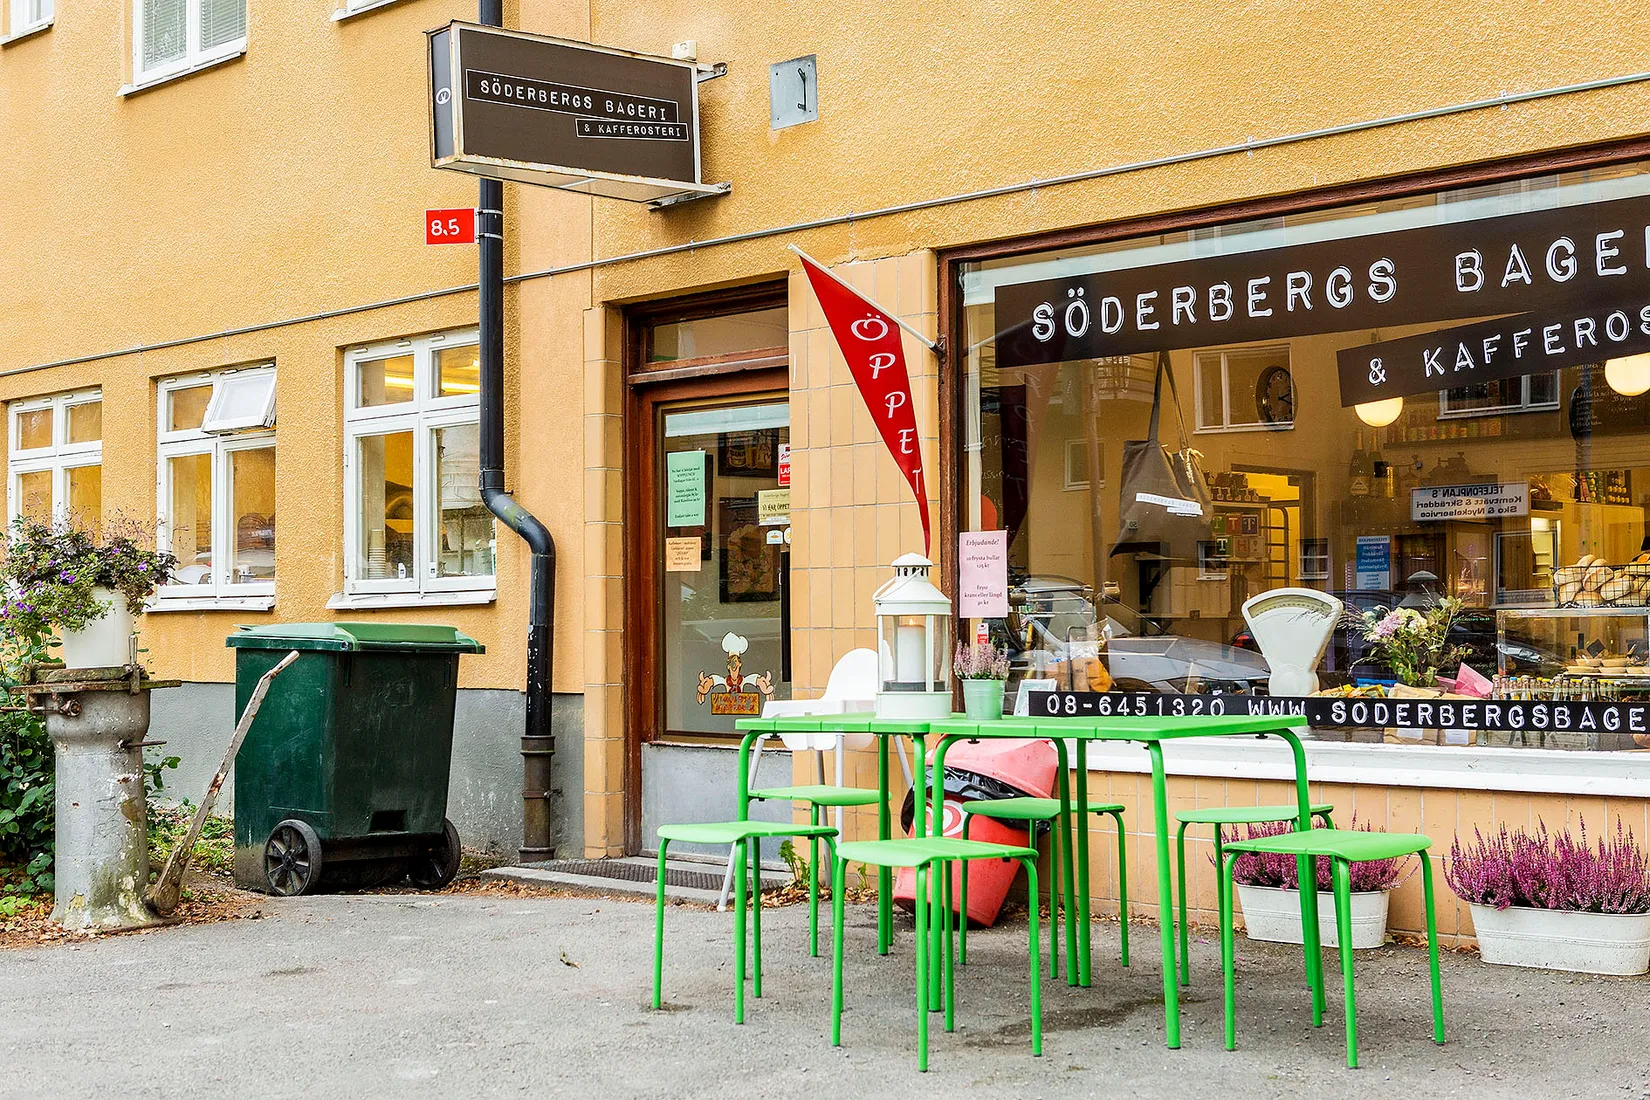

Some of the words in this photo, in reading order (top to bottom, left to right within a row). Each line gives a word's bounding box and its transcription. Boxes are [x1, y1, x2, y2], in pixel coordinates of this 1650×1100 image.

[480, 78, 593, 110] SÖDERBERGS
[605, 100, 667, 121] BAGERI
[584, 123, 590, 133] &
[598, 124, 681, 137] KAFFEROSTERI
[1031, 256, 1398, 343] SÖDERBERGS
[1368, 356, 1387, 387] &
[850, 312, 923, 494] ÖPPET
[1046, 694, 1225, 717] 08-6451320
